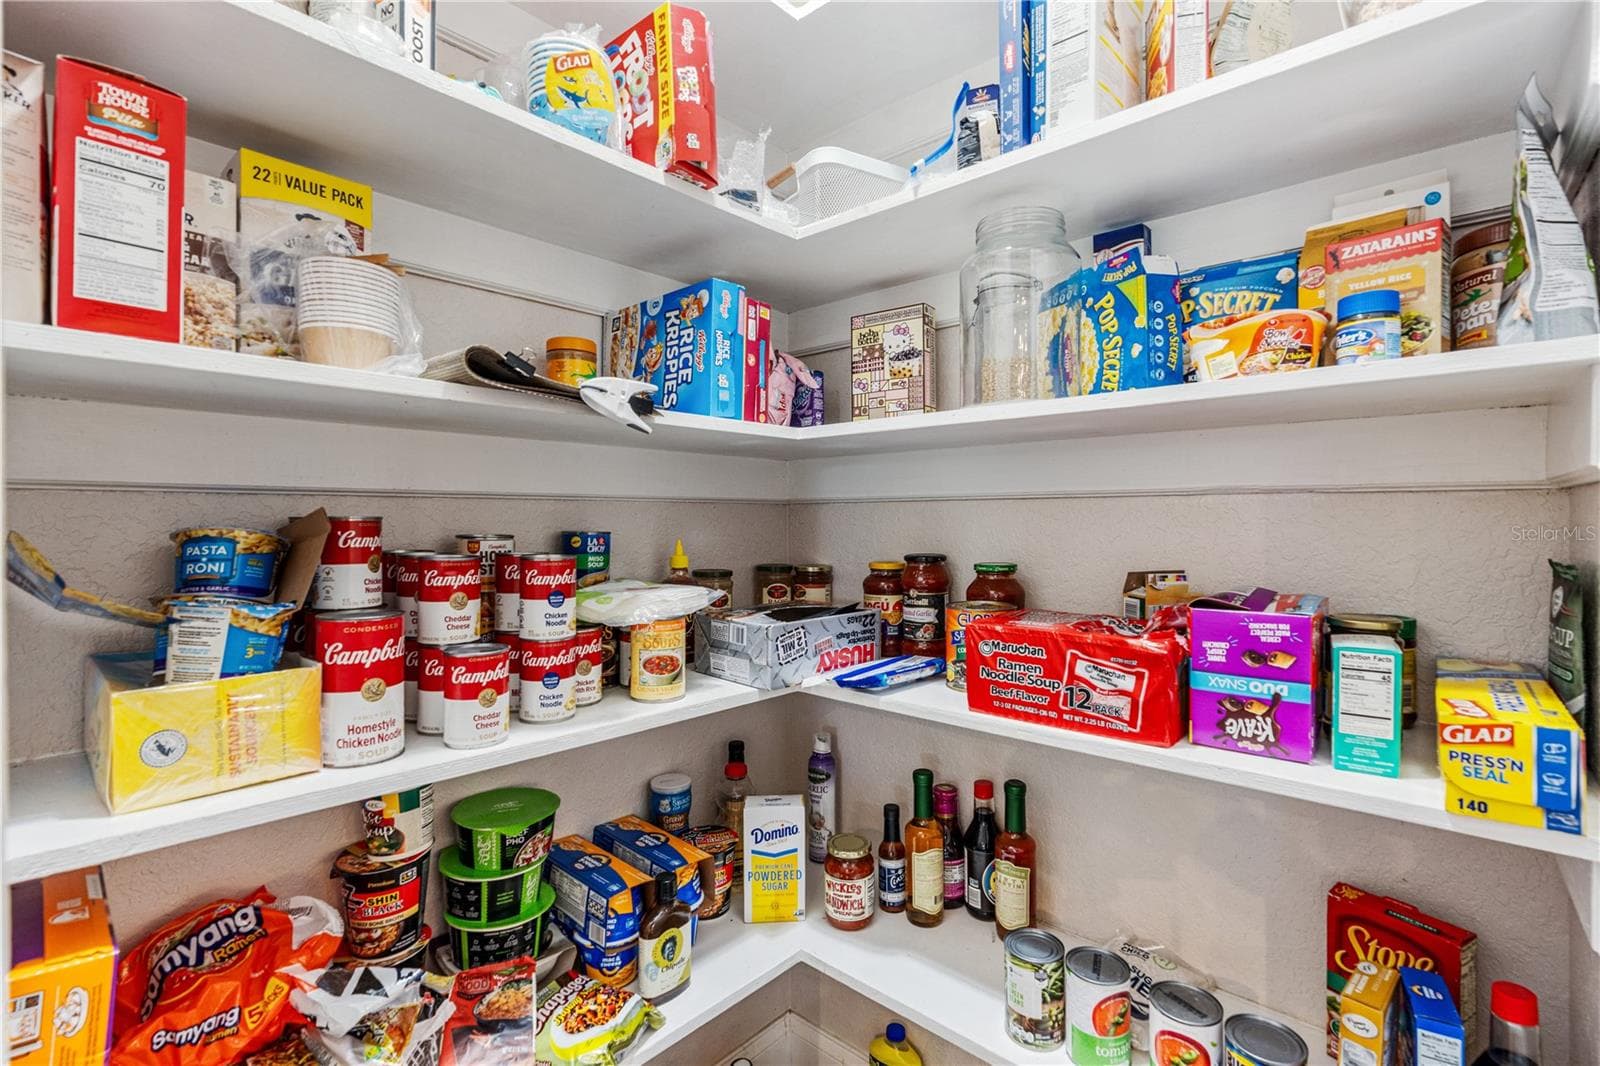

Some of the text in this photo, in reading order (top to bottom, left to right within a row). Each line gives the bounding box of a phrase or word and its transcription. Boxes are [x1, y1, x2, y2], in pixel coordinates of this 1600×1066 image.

[412, 18, 424, 64] OOST
[555, 55, 591, 71] GLAD
[657, 12, 670, 120] FAMILY SIZE
[619, 30, 654, 129] FROOT
[97, 81, 149, 107] TOWN
[97, 92, 150, 118] HOUSE
[149, 181, 166, 192] 70
[252, 166, 364, 210] 22 VALUE PACK
[1340, 226, 1439, 260] ZATARAIN'S
[1348, 272, 1412, 290] YELLOW RICE
[677, 327, 694, 385] RICE
[722, 338, 730, 361] RICE
[664, 309, 680, 410] KRISPIES
[587, 537, 598, 545] LA
[186, 545, 227, 556] PASTA
[186, 563, 225, 574] RONI
[444, 615, 472, 623] Cheddar
[544, 612, 568, 620] Chicken
[545, 619, 567, 627] Noodle
[862, 613, 876, 627] 22
[343, 623, 399, 633] CONDENSED
[446, 623, 470, 631] Cheese
[780, 636, 803, 653] 2 MIL
[990, 641, 1046, 659] Maruchan
[816, 642, 875, 674] HUSKY
[997, 658, 1042, 675] Ramen
[980, 667, 1062, 691] Noodle Soup
[1208, 676, 1289, 697] DUO SNAX
[538, 692, 564, 701] Chicken
[991, 686, 1049, 704] Beef Flavor
[1064, 686, 1123, 718] 12 PACK
[539, 699, 563, 709] Noodle
[472, 711, 501, 722] Cheddar
[347, 717, 397, 736] Homestyle
[475, 721, 500, 730] Cheese
[1441, 725, 1512, 743] GLAD
[336, 736, 376, 750] Chicken
[358, 745, 390, 760] SOUP
[1462, 765, 1509, 784] SEAL
[1457, 797, 1488, 814] 140
[505, 836, 525, 846] PHO
[751, 823, 799, 844] Domino
[747, 869, 802, 882] POWDERED
[761, 881, 789, 891] SUGAR
[367, 892, 399, 907] SHIN
[362, 900, 404, 917] BLACK
[246, 1007, 264, 1026] 5
[152, 1006, 241, 1052] Samyang
